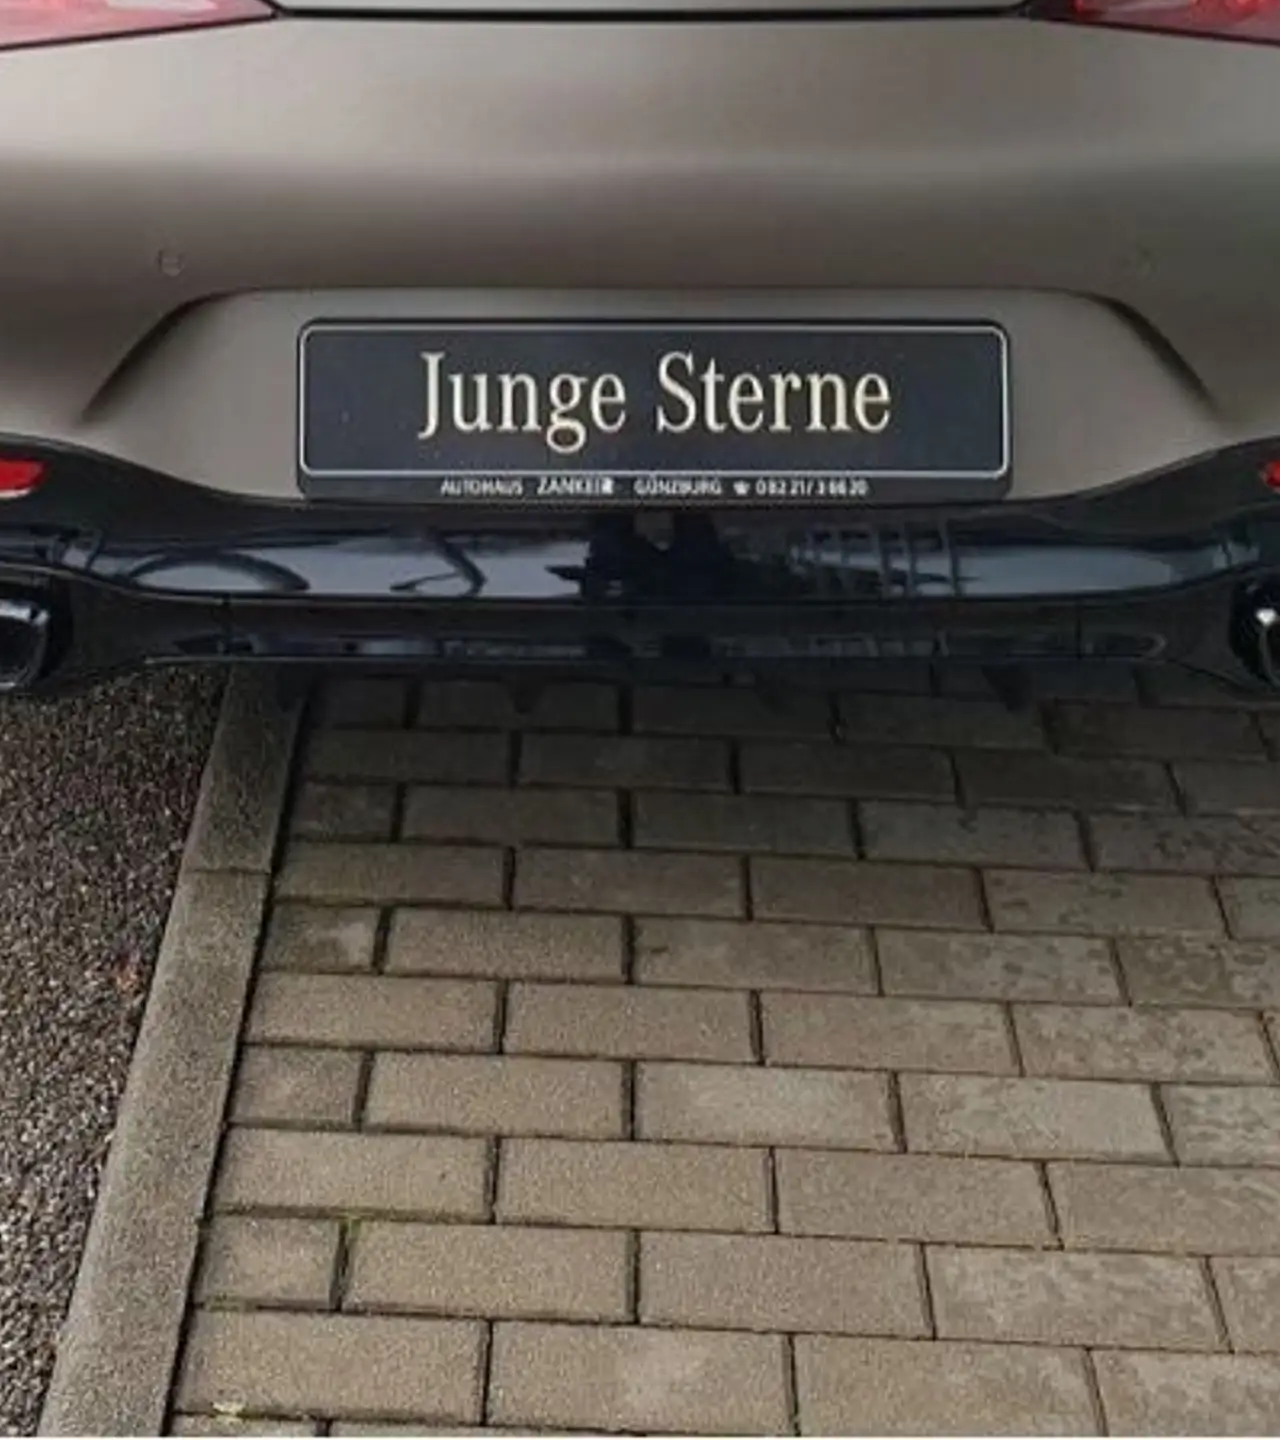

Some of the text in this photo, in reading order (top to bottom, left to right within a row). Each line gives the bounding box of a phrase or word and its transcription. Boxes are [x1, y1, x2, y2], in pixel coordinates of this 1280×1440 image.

[418, 350, 892, 454] Junge Sterne
[440, 476, 523, 496] AUTOHAUS
[633, 473, 722, 496] GÜNZBURG
